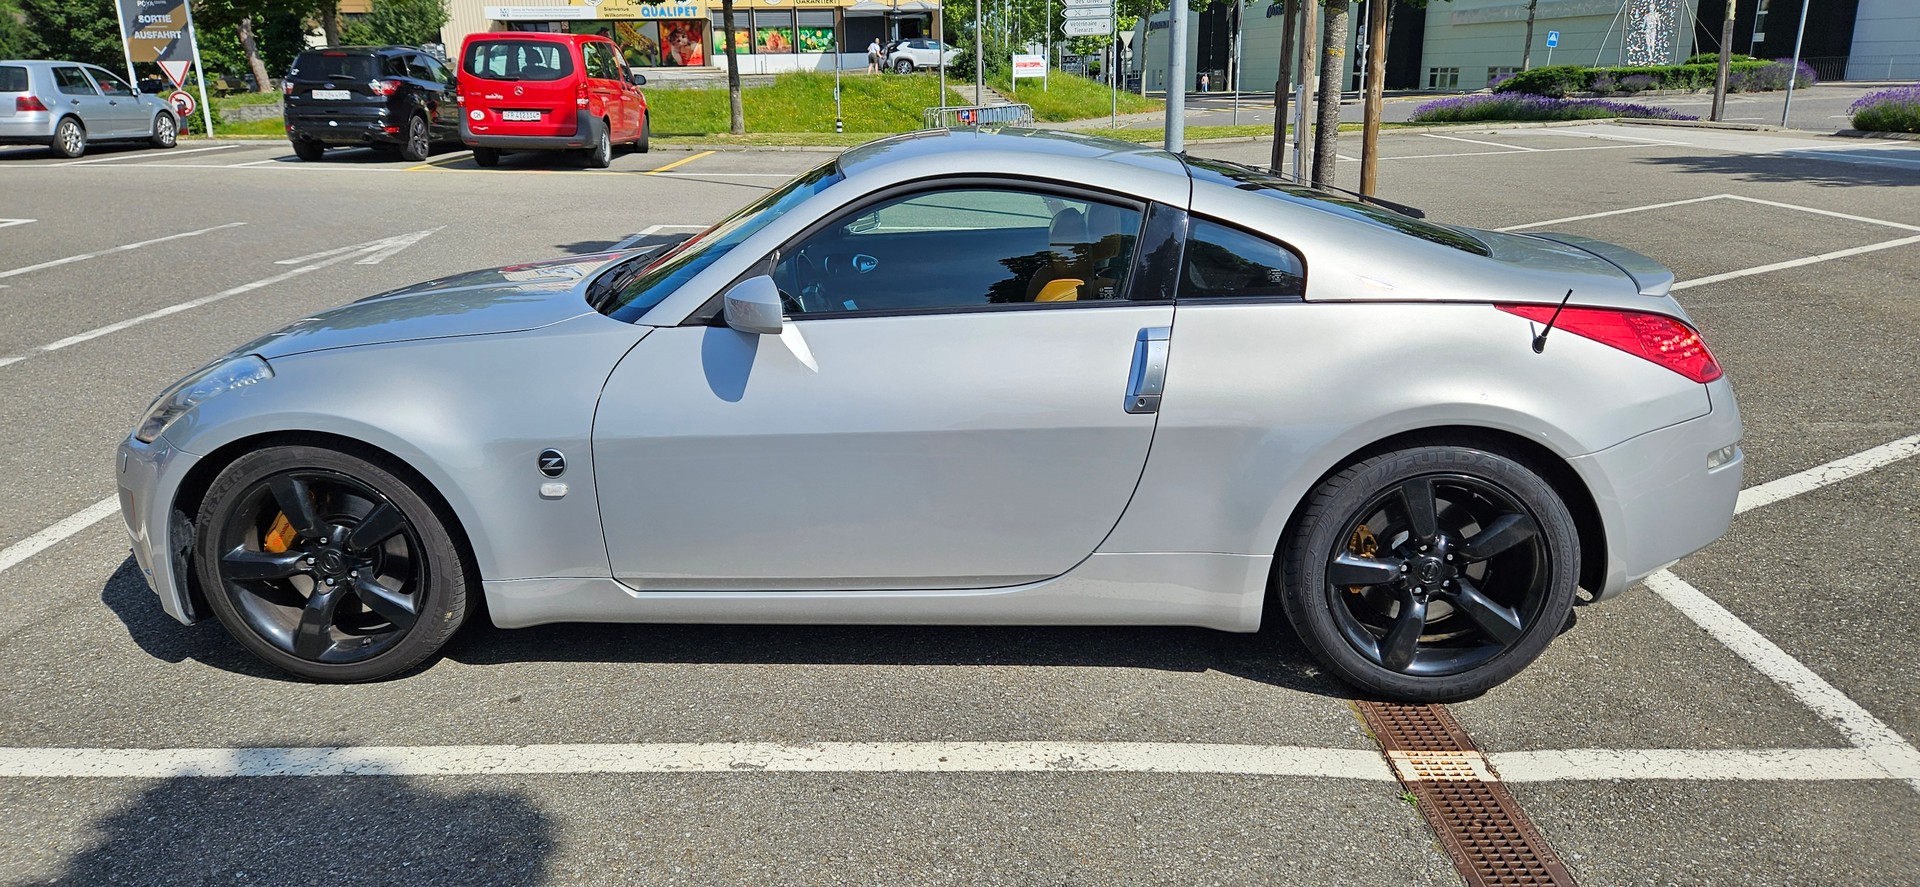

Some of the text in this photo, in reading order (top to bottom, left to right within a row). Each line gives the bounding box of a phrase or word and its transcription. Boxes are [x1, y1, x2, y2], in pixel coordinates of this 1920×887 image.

[641, 6, 698, 17] QUALIPET
[138, 15, 172, 23] SORTIE
[134, 31, 182, 39] AUSFAHRT
[541, 457, 564, 470] Z
[1397, 451, 1504, 472] FULDA
[201, 468, 244, 527] NEXEN
